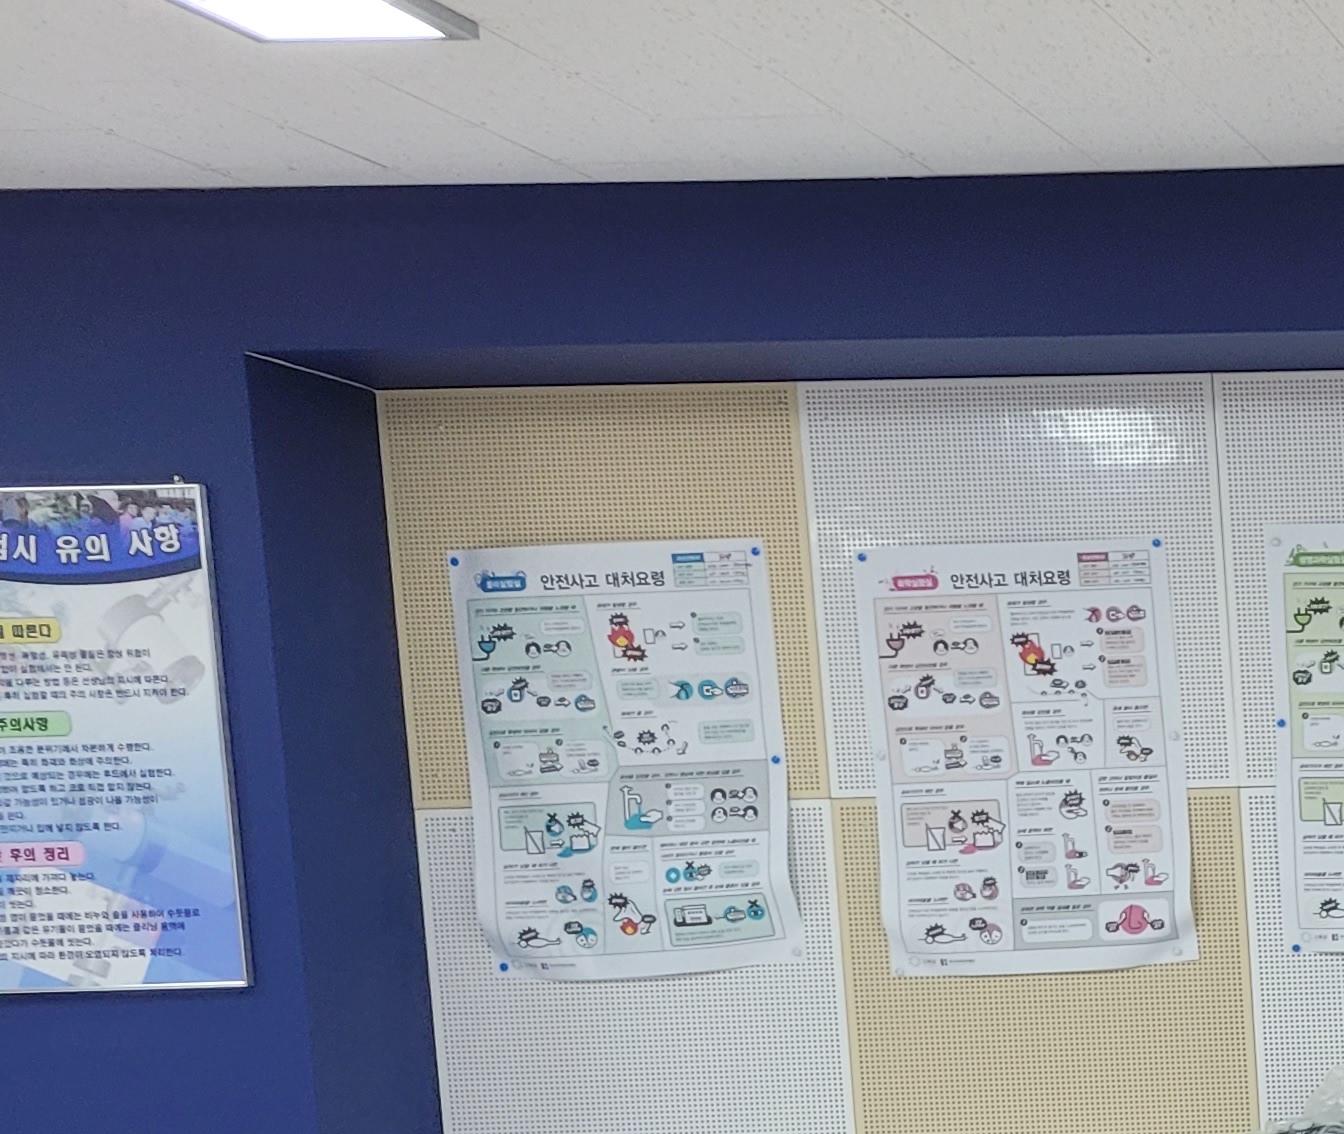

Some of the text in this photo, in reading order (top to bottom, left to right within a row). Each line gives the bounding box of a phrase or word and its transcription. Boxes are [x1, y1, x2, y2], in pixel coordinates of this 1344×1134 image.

[56, 533, 111, 564] 유의
[129, 524, 181, 557] 사항
[540, 573, 600, 590] 안전사고
[606, 571, 665, 587] 대처요령
[951, 573, 1008, 590] 안전사고
[1015, 570, 1071, 587] 대처요령
[10, 847, 69, 862] 후의 정리
